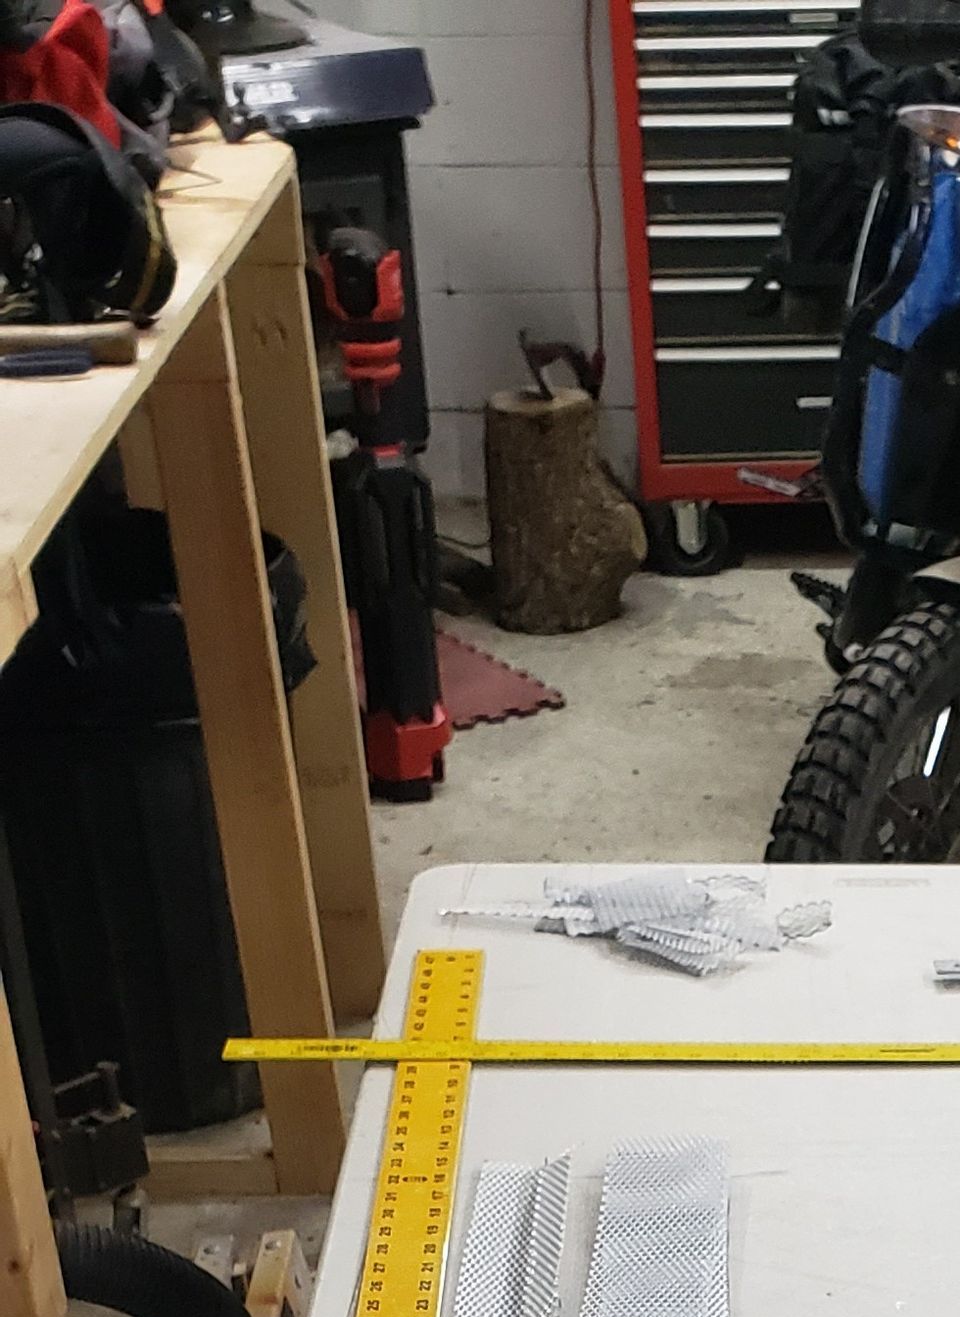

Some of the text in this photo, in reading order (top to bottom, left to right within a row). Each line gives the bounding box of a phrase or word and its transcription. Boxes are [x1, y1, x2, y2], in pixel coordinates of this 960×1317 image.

[373, 1262, 385, 1273] 27
[421, 1262, 434, 1272] 21
[370, 1281, 383, 1291] 26
[419, 1281, 431, 1291] 22
[367, 1300, 379, 1311] 25
[416, 1300, 429, 1310] 23
